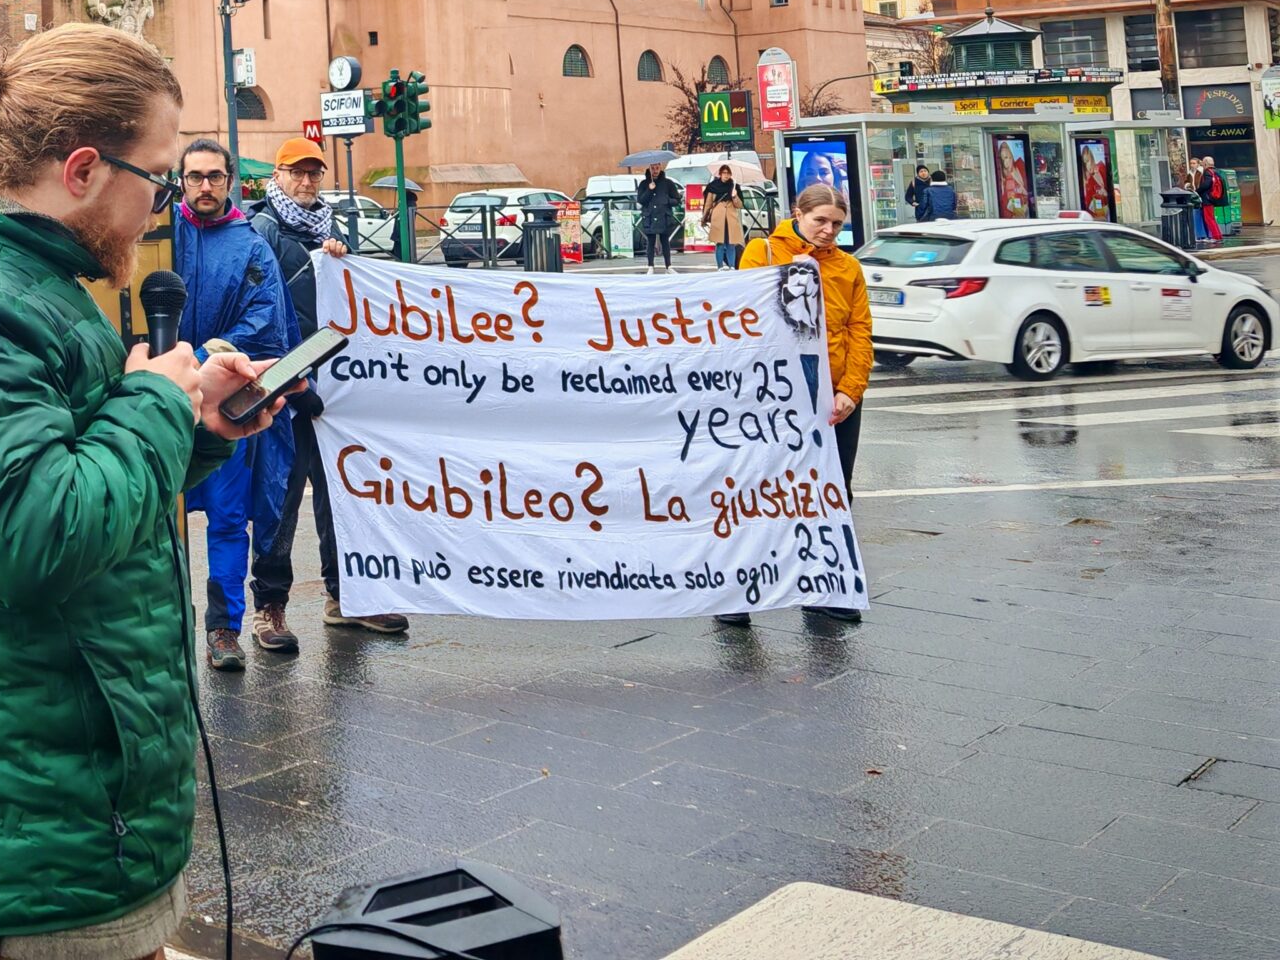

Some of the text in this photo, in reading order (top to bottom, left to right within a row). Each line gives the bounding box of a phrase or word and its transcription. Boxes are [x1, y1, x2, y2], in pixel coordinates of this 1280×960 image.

[323, 96, 362, 111] SCIFONI
[328, 268, 763, 352] Jubilee? Justice
[330, 352, 410, 381] can't
[423, 359, 487, 404] only
[502, 362, 535, 393] be
[561, 362, 677, 396] reclaimed
[687, 369, 743, 399] every
[752, 358, 793, 403] 25
[337, 444, 847, 539] Giubileo? La giustizia
[344, 522, 839, 605] non può essere rivendicata solo ogni 25
